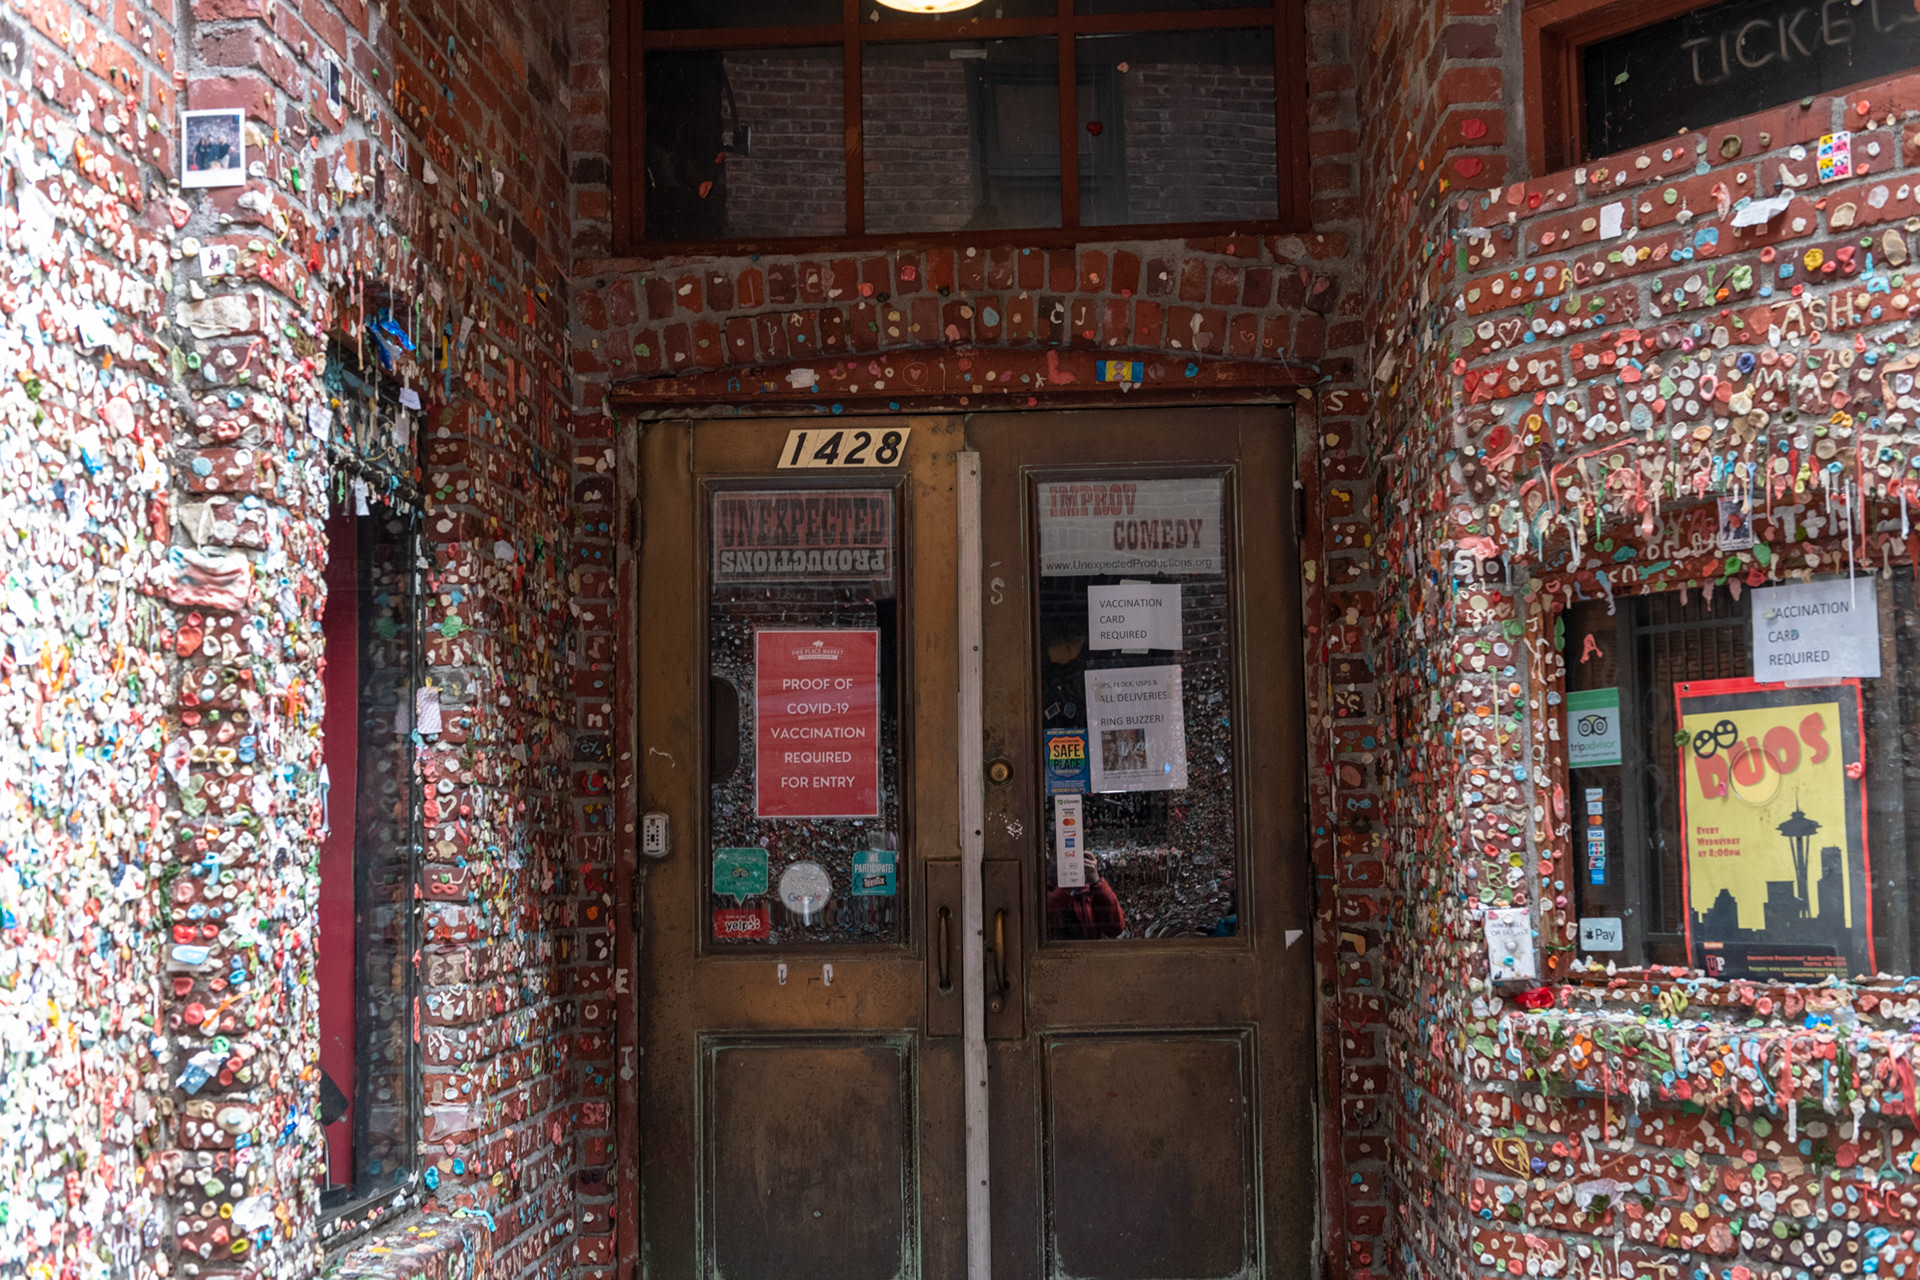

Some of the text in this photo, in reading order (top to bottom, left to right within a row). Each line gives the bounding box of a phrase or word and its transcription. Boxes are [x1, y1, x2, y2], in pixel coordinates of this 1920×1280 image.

[790, 431, 902, 466] 1428
[1050, 484, 1137, 517] IMPROV
[720, 498, 886, 547] UNEXPECTED
[1113, 518, 1203, 551] COMEDY
[720, 550, 886, 574] PRODUCTIONS
[1046, 558, 1212, 570] www.UnexpectedProductions.org
[1099, 598, 1163, 609] VACCINATION
[1770, 600, 1850, 619] ACCINATION
[1100, 615, 1125, 624] CARD
[1100, 630, 1147, 640] REQUIRED
[1768, 629, 1799, 644] CARD
[1769, 650, 1830, 667] REQUIRED
[782, 678, 853, 690] PROOF OF
[1117, 690, 1167, 702] DELIVERIES
[787, 703, 849, 715] COVID-19
[1100, 714, 1165, 726] RING BUZZER!
[771, 727, 866, 739] VACCINATION
[1053, 744, 1080, 757] SAFE
[1570, 740, 1616, 753] tripadvisor
[784, 752, 852, 764] REQUIRED
[1694, 712, 1830, 799] DUOS
[1053, 758, 1081, 770] PLACE
[781, 776, 855, 788] FOR ENTRY
[869, 853, 879, 862] WE
[854, 863, 894, 874] PARTICIPATE!
[787, 892, 822, 904] Gogle
[725, 921, 749, 932] yelp
[1595, 928, 1615, 943] Pay
